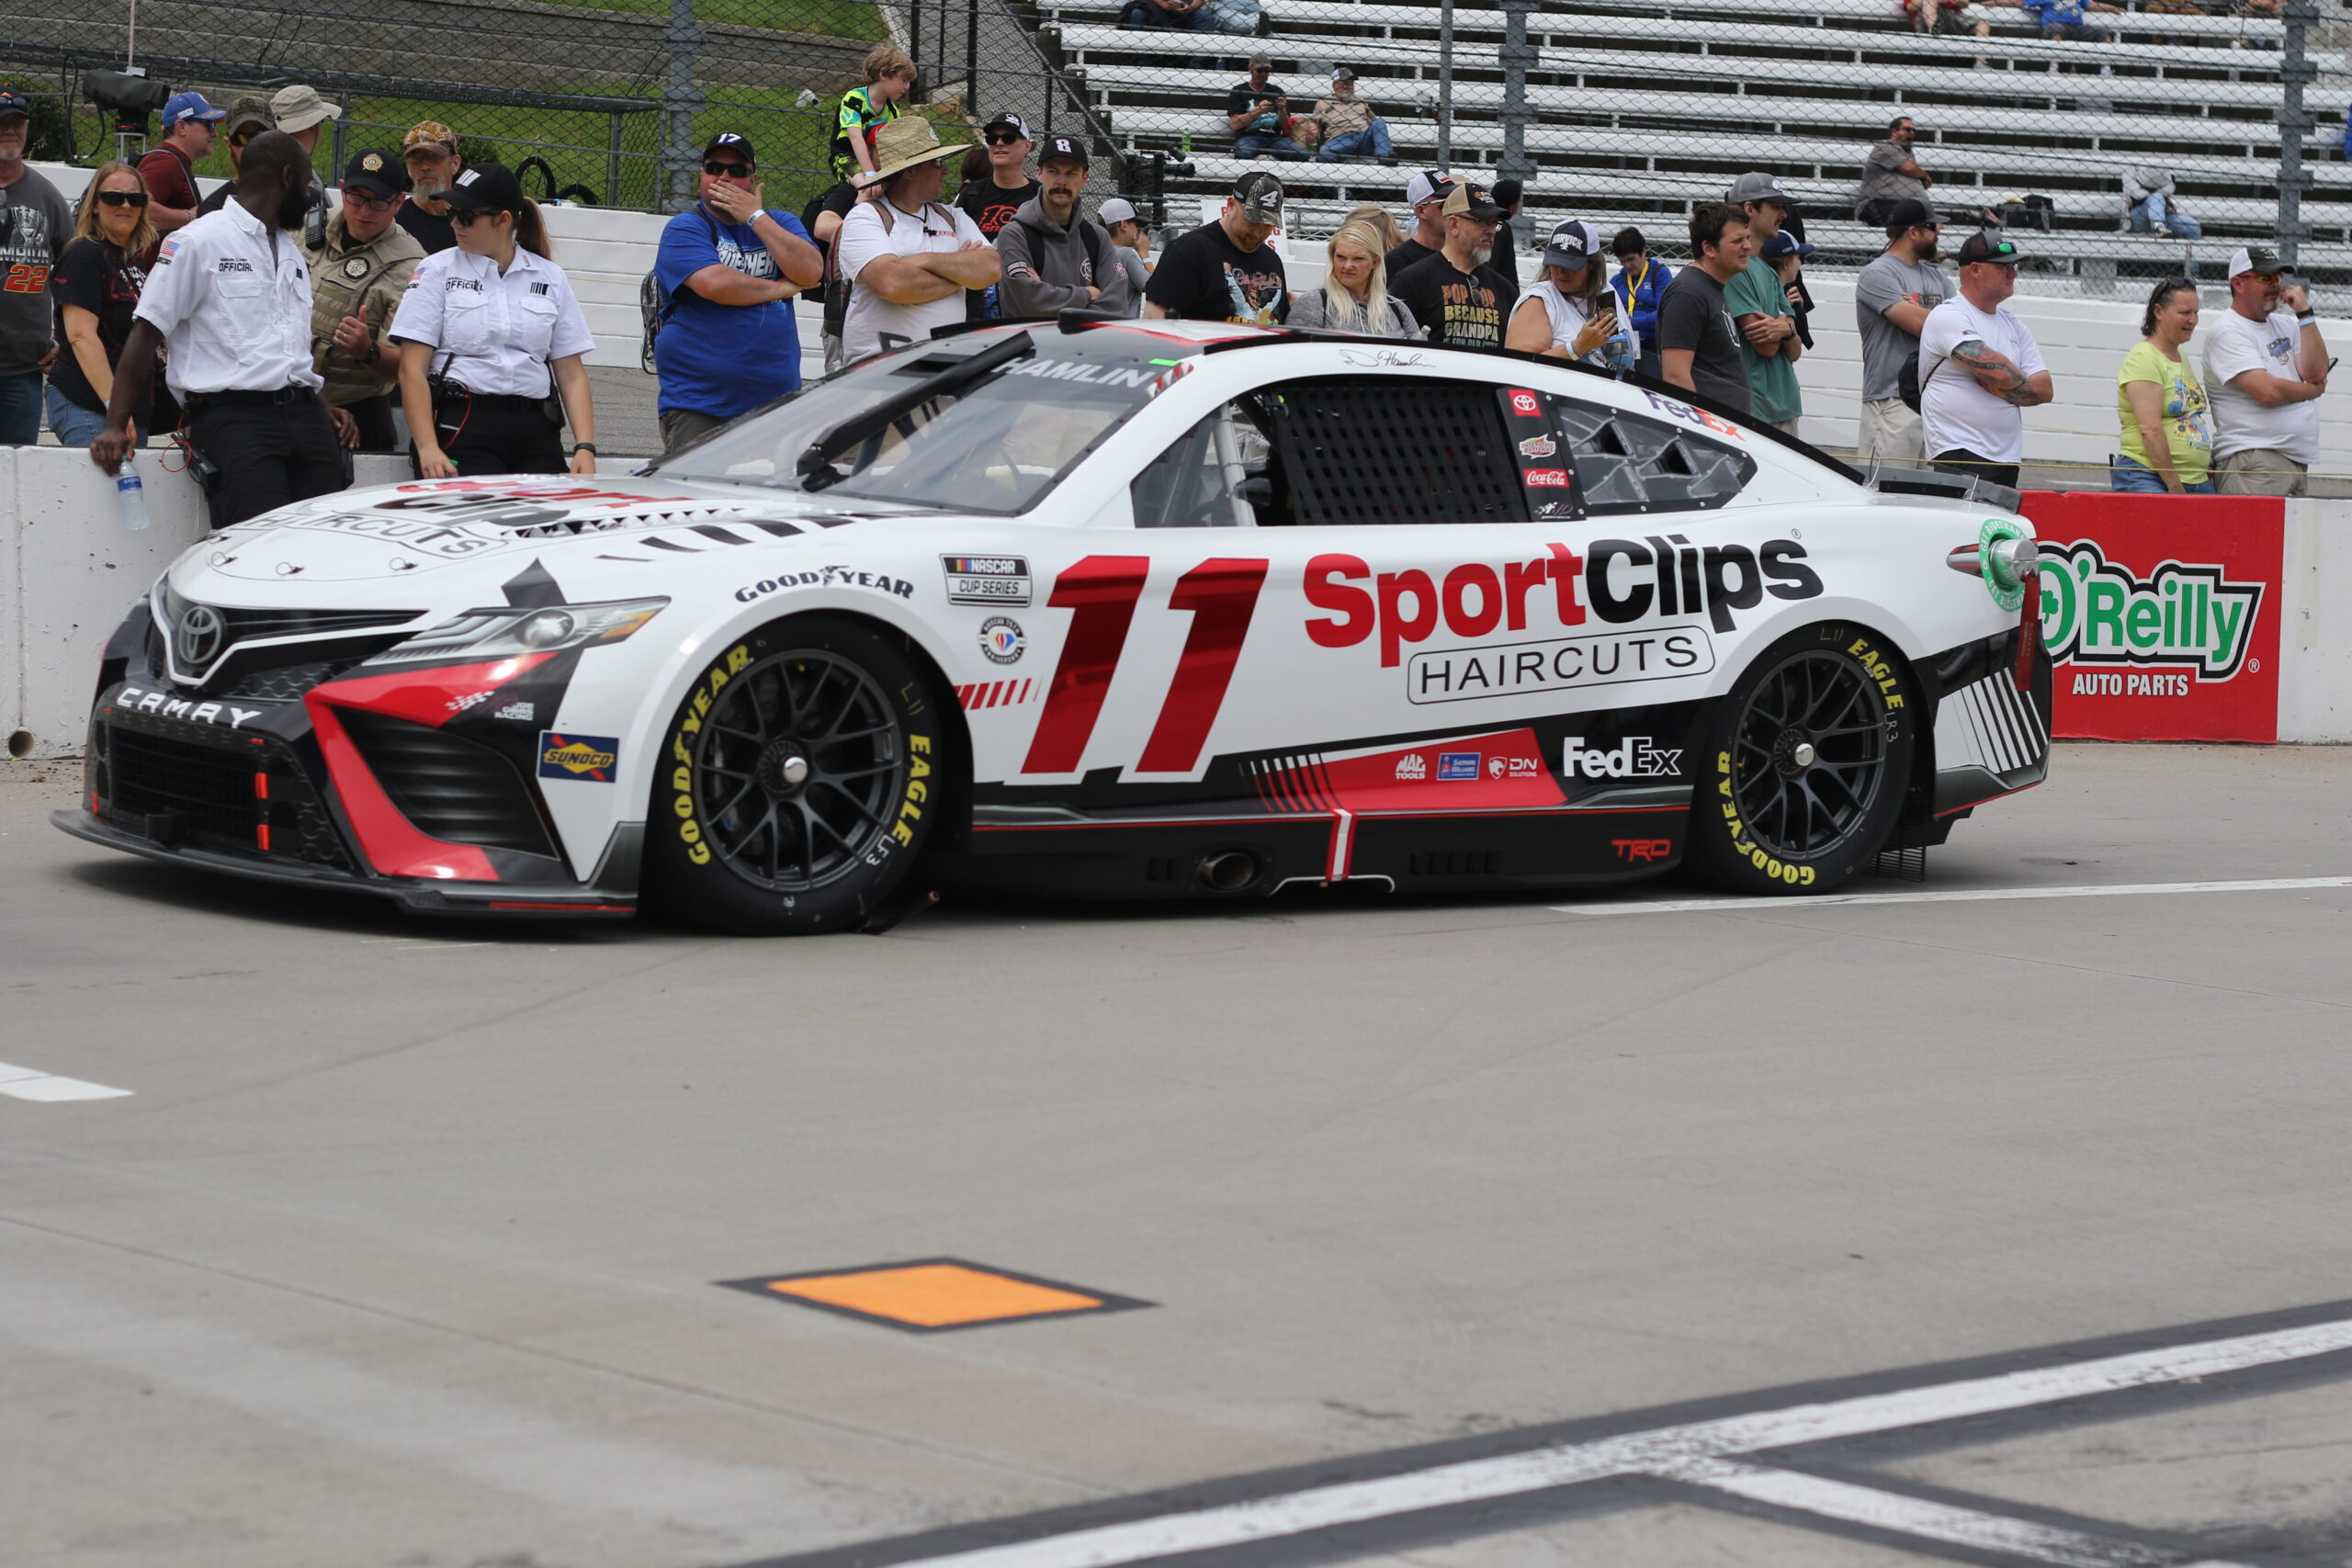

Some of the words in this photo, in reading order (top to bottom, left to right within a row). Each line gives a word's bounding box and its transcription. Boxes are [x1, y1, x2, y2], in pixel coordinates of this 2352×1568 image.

[718, 132, 742, 144] 17
[1056, 138, 1072, 153] 8
[1260, 190, 1279, 208] 4
[1551, 232, 1584, 252] HARVICK
[219, 262, 254, 273] OFFICIAL
[4, 264, 50, 294] 22
[1441, 283, 1469, 306] POP
[1443, 304, 1500, 325] BECAUSE
[1443, 321, 1499, 342] GRANDPA
[990, 355, 1157, 389] HAMLIN
[1639, 386, 1747, 442] FedEx
[243, 514, 489, 554] HIRCUTS
[971, 558, 1016, 574] NASCAR
[959, 580, 980, 592] CUP
[981, 581, 1020, 594] SERIES
[1020, 554, 1270, 774] 11
[1420, 635, 1699, 695] HAIRCUTS
[1847, 637, 1905, 710] EAGLE
[2072, 673, 2123, 696] AUTO
[2127, 673, 2189, 697] PARTS
[117, 687, 263, 729] CAMRY
[494, 712, 534, 721] RACING
[547, 750, 612, 766] SUNOCO
[1396, 753, 1427, 773] MAC
[1509, 758, 1538, 770] DN
[1564, 737, 1684, 778] FedEx
[1395, 772, 1426, 780] TOOLS
[891, 734, 932, 848] EAGLE
[1611, 839, 1672, 863] TRD
